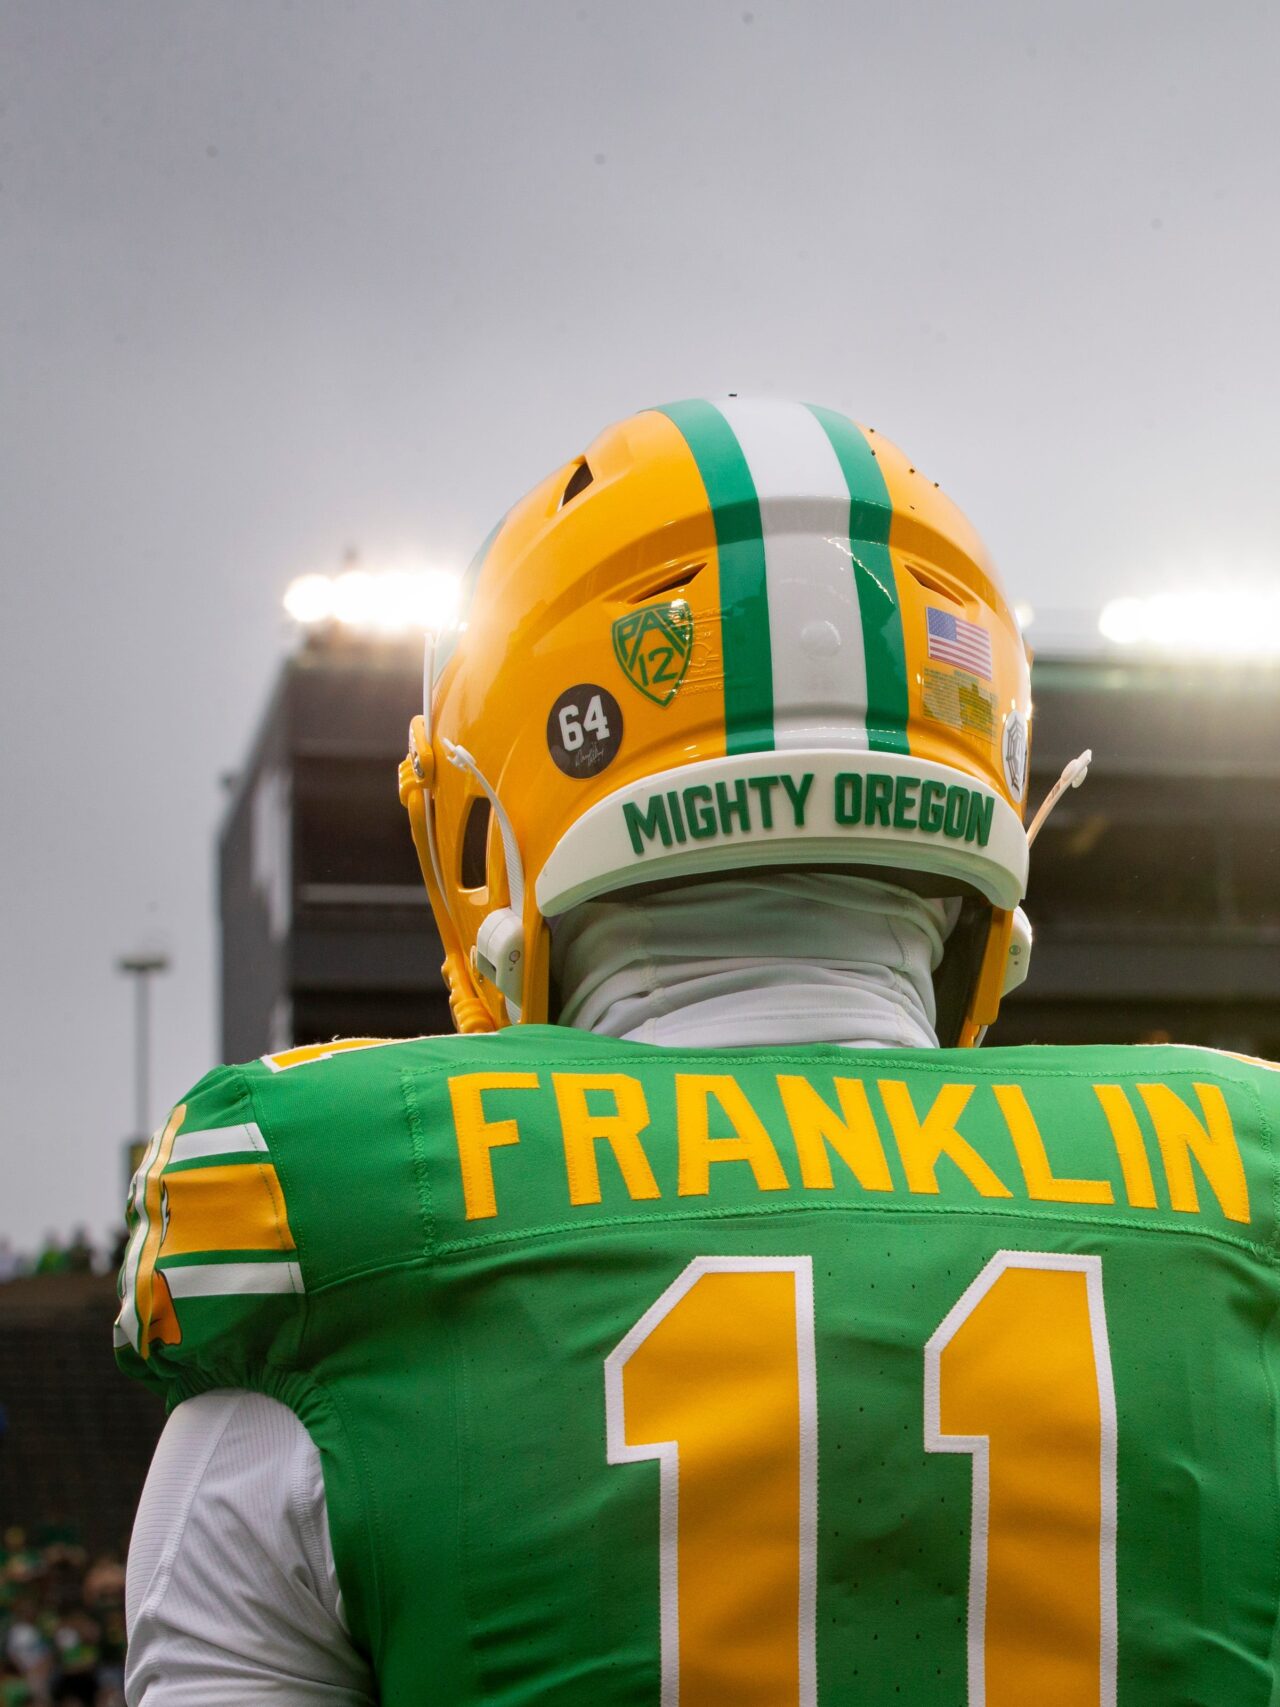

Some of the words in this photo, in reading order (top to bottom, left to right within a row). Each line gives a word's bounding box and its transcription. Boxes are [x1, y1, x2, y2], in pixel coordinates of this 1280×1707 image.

[638, 646, 680, 687] 12
[558, 694, 611, 751] 64
[622, 773, 815, 856] MIGHTY
[834, 773, 996, 847] OREGON
[447, 1071, 1252, 1225] FRANKLIN
[604, 1250, 1118, 1707] 11
